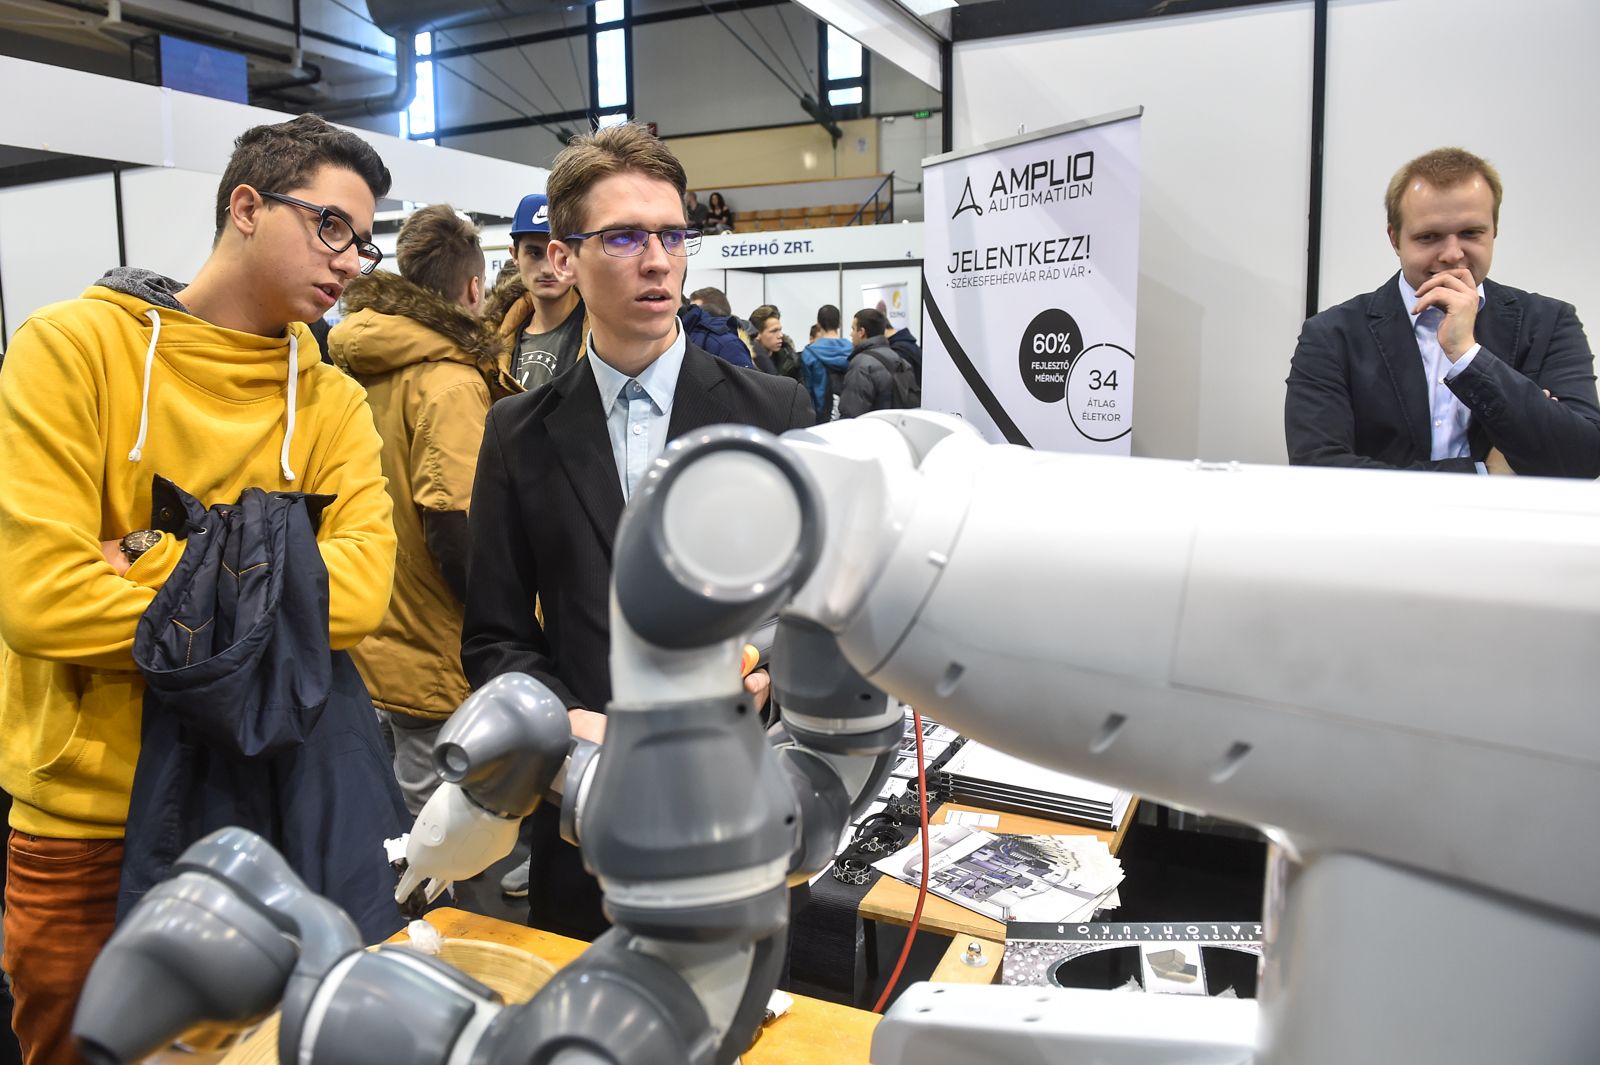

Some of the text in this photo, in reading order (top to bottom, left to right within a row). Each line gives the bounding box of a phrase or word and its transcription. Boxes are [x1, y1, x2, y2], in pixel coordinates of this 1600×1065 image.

[989, 151, 1094, 198] AMPLIO
[988, 182, 1093, 213] AUTOMATION
[721, 239, 814, 258] SZÉPHŐ ZRT.
[947, 234, 1091, 274] JELENTKEZZ!
[951, 264, 1085, 289] SZÉKESFEHÉRVÁR RÁD VÁR
[1033, 332, 1071, 354] 60%
[1035, 373, 1065, 383] MÉRNÖK
[1088, 369, 1119, 391] 34
[1087, 397, 1116, 408] ÁTLAG
[1082, 410, 1121, 422] ÉLETKOR
[1057, 924, 1263, 935] ZALONCUKOR
